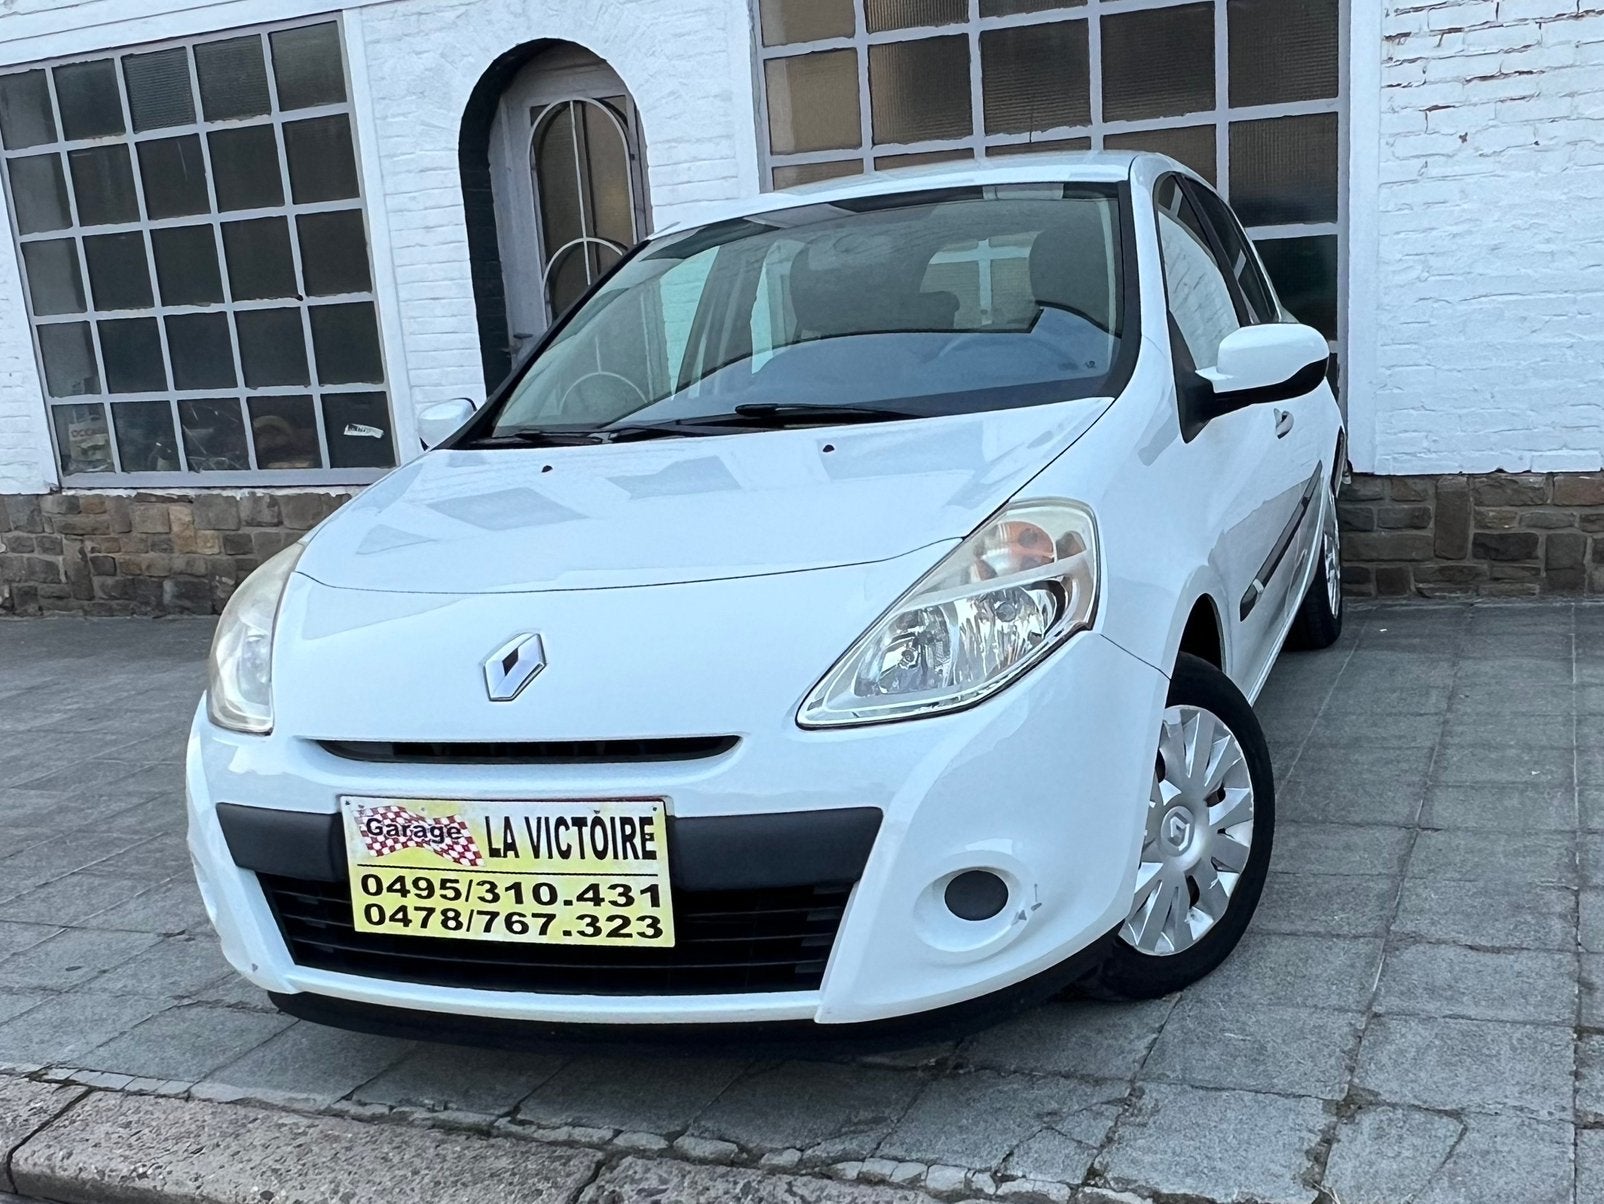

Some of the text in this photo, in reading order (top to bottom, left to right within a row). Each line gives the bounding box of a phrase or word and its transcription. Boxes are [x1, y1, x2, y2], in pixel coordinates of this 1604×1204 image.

[365, 815, 658, 861] Garage LA VICTOIRE
[360, 873, 661, 908] 0495/310.431
[363, 903, 664, 939] 0478/767.323
